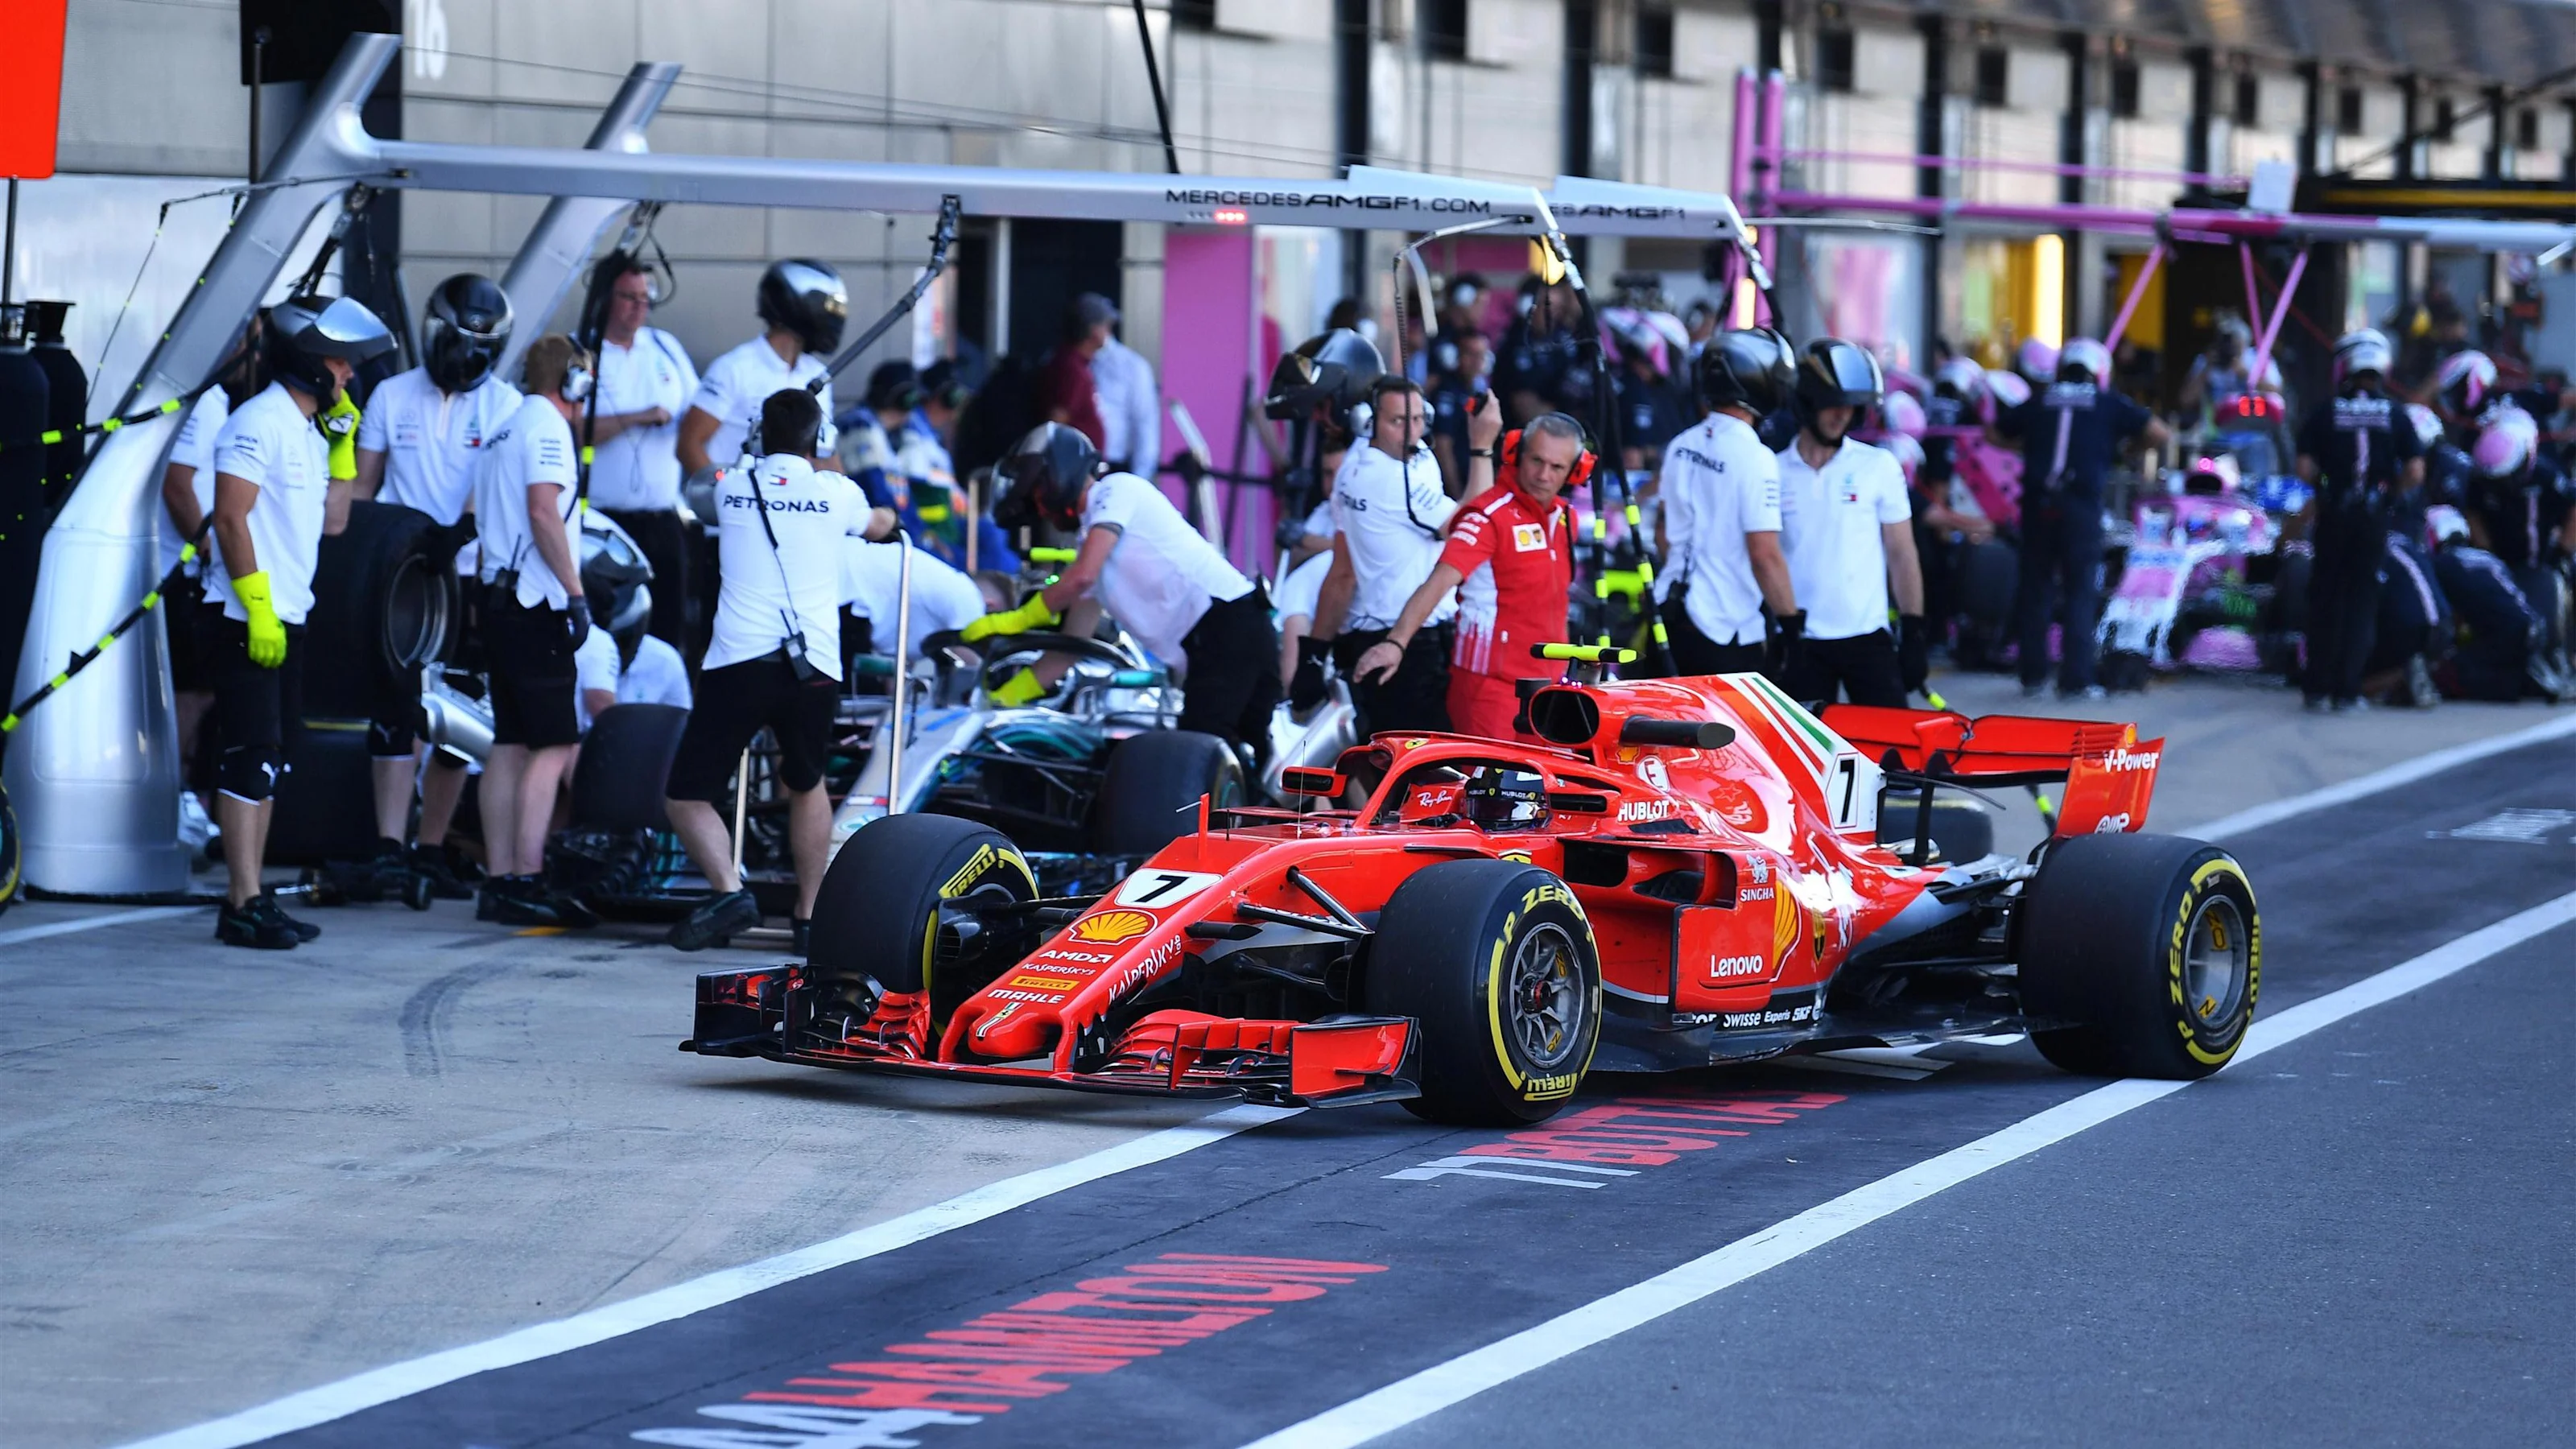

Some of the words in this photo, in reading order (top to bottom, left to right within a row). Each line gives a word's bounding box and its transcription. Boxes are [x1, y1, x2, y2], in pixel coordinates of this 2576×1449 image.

[1166, 189, 1491, 213] MERCEDESAMGF1.COM
[2103, 749, 2159, 773] V-Power
[1644, 760, 1663, 788] E
[1417, 791, 1452, 807] Ray-Ban
[1839, 759, 1855, 824] 7
[1617, 800, 1670, 822] HUBLOT
[1133, 874, 1191, 902] 7
[1740, 887, 1775, 902] SINGHA
[1503, 910, 1516, 945] P
[1521, 884, 1585, 922] ZERO
[1038, 949, 1095, 961] AMD
[2169, 890, 2193, 1006] ZERO
[1022, 963, 1089, 975] KASPERSKY
[1710, 955, 1764, 978] Lenovo
[1018, 978, 1071, 989] PIRELLI
[988, 989, 1066, 1004] MAHLE
[1764, 1009, 1791, 1023] Experis
[1792, 1005, 1812, 1022] SKF
[1524, 1072, 1578, 1101] PIRELLI
[742, 1253, 1390, 1414] HAMILTON
